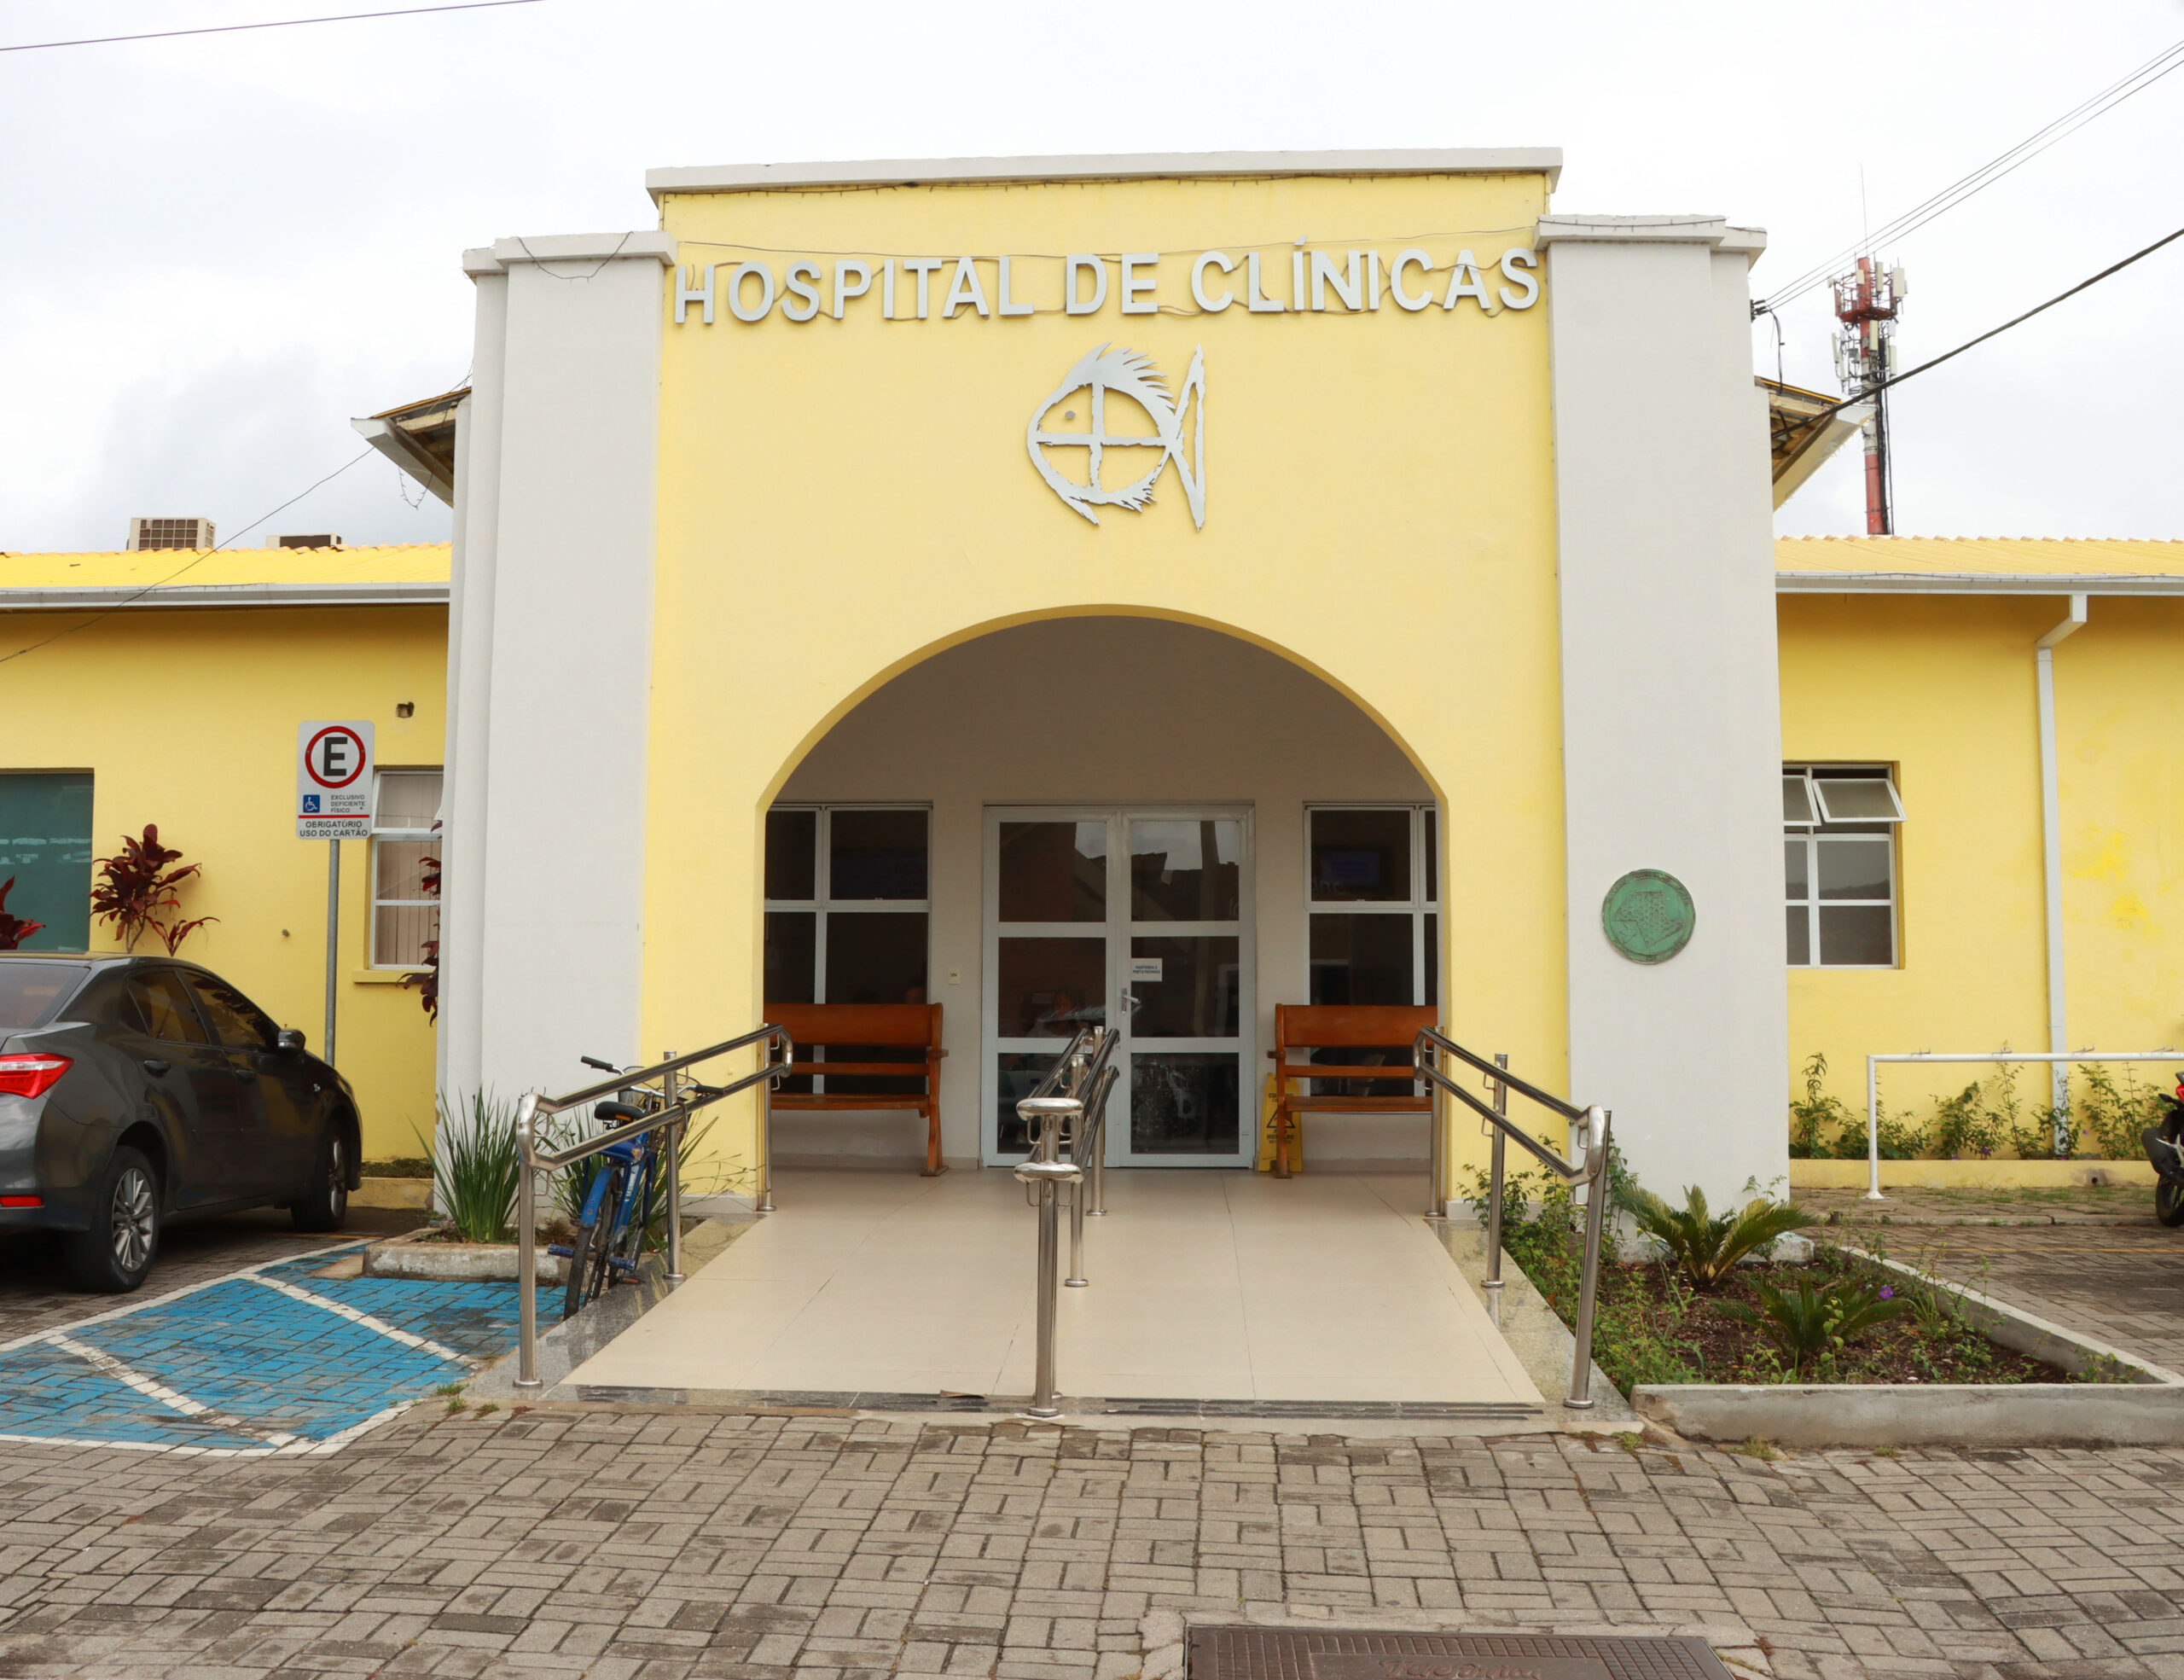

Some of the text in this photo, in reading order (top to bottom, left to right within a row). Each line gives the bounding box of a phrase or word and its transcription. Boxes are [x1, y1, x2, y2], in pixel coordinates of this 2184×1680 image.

[674, 235, 1539, 324] HOSPITAL DE CLÍNICAS
[323, 736, 348, 776] E
[305, 819, 363, 828] OBRIGATÓRIO
[333, 828, 369, 837] CARTÃO
